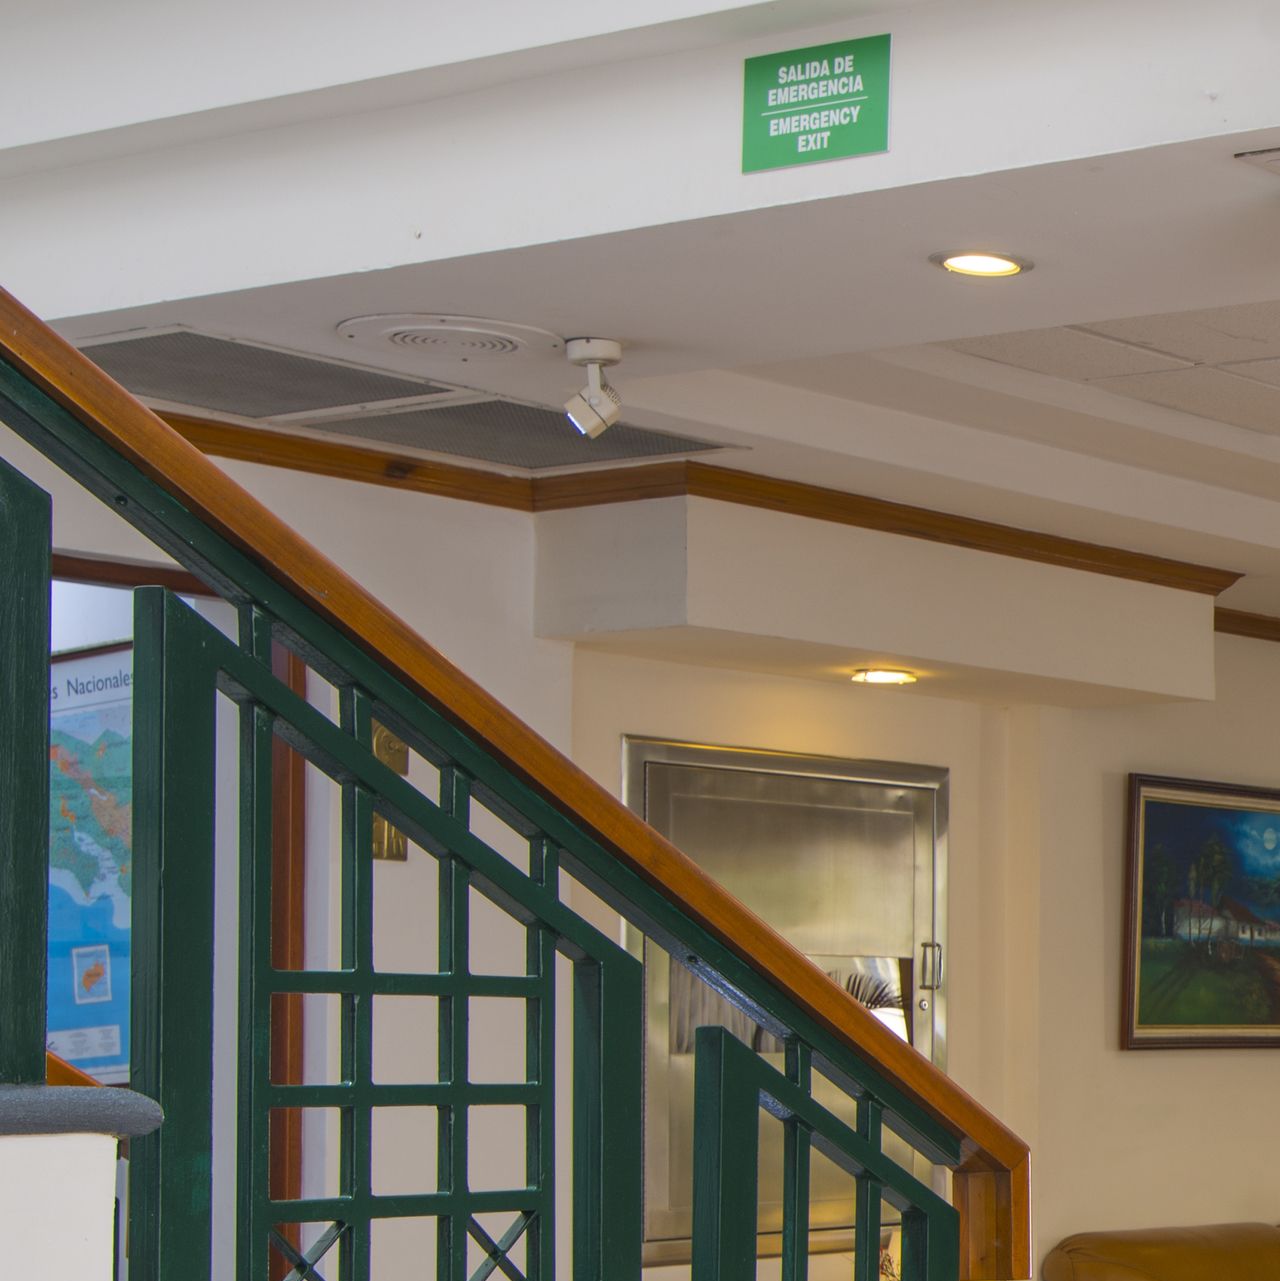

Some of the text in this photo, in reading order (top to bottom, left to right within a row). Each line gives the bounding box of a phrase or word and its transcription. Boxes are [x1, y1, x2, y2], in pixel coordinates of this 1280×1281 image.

[778, 55, 854, 84] SALIDA DE
[767, 74, 863, 106] EMERGENCIA
[769, 105, 860, 136] EMERGENCY
[798, 131, 830, 152] EXIT
